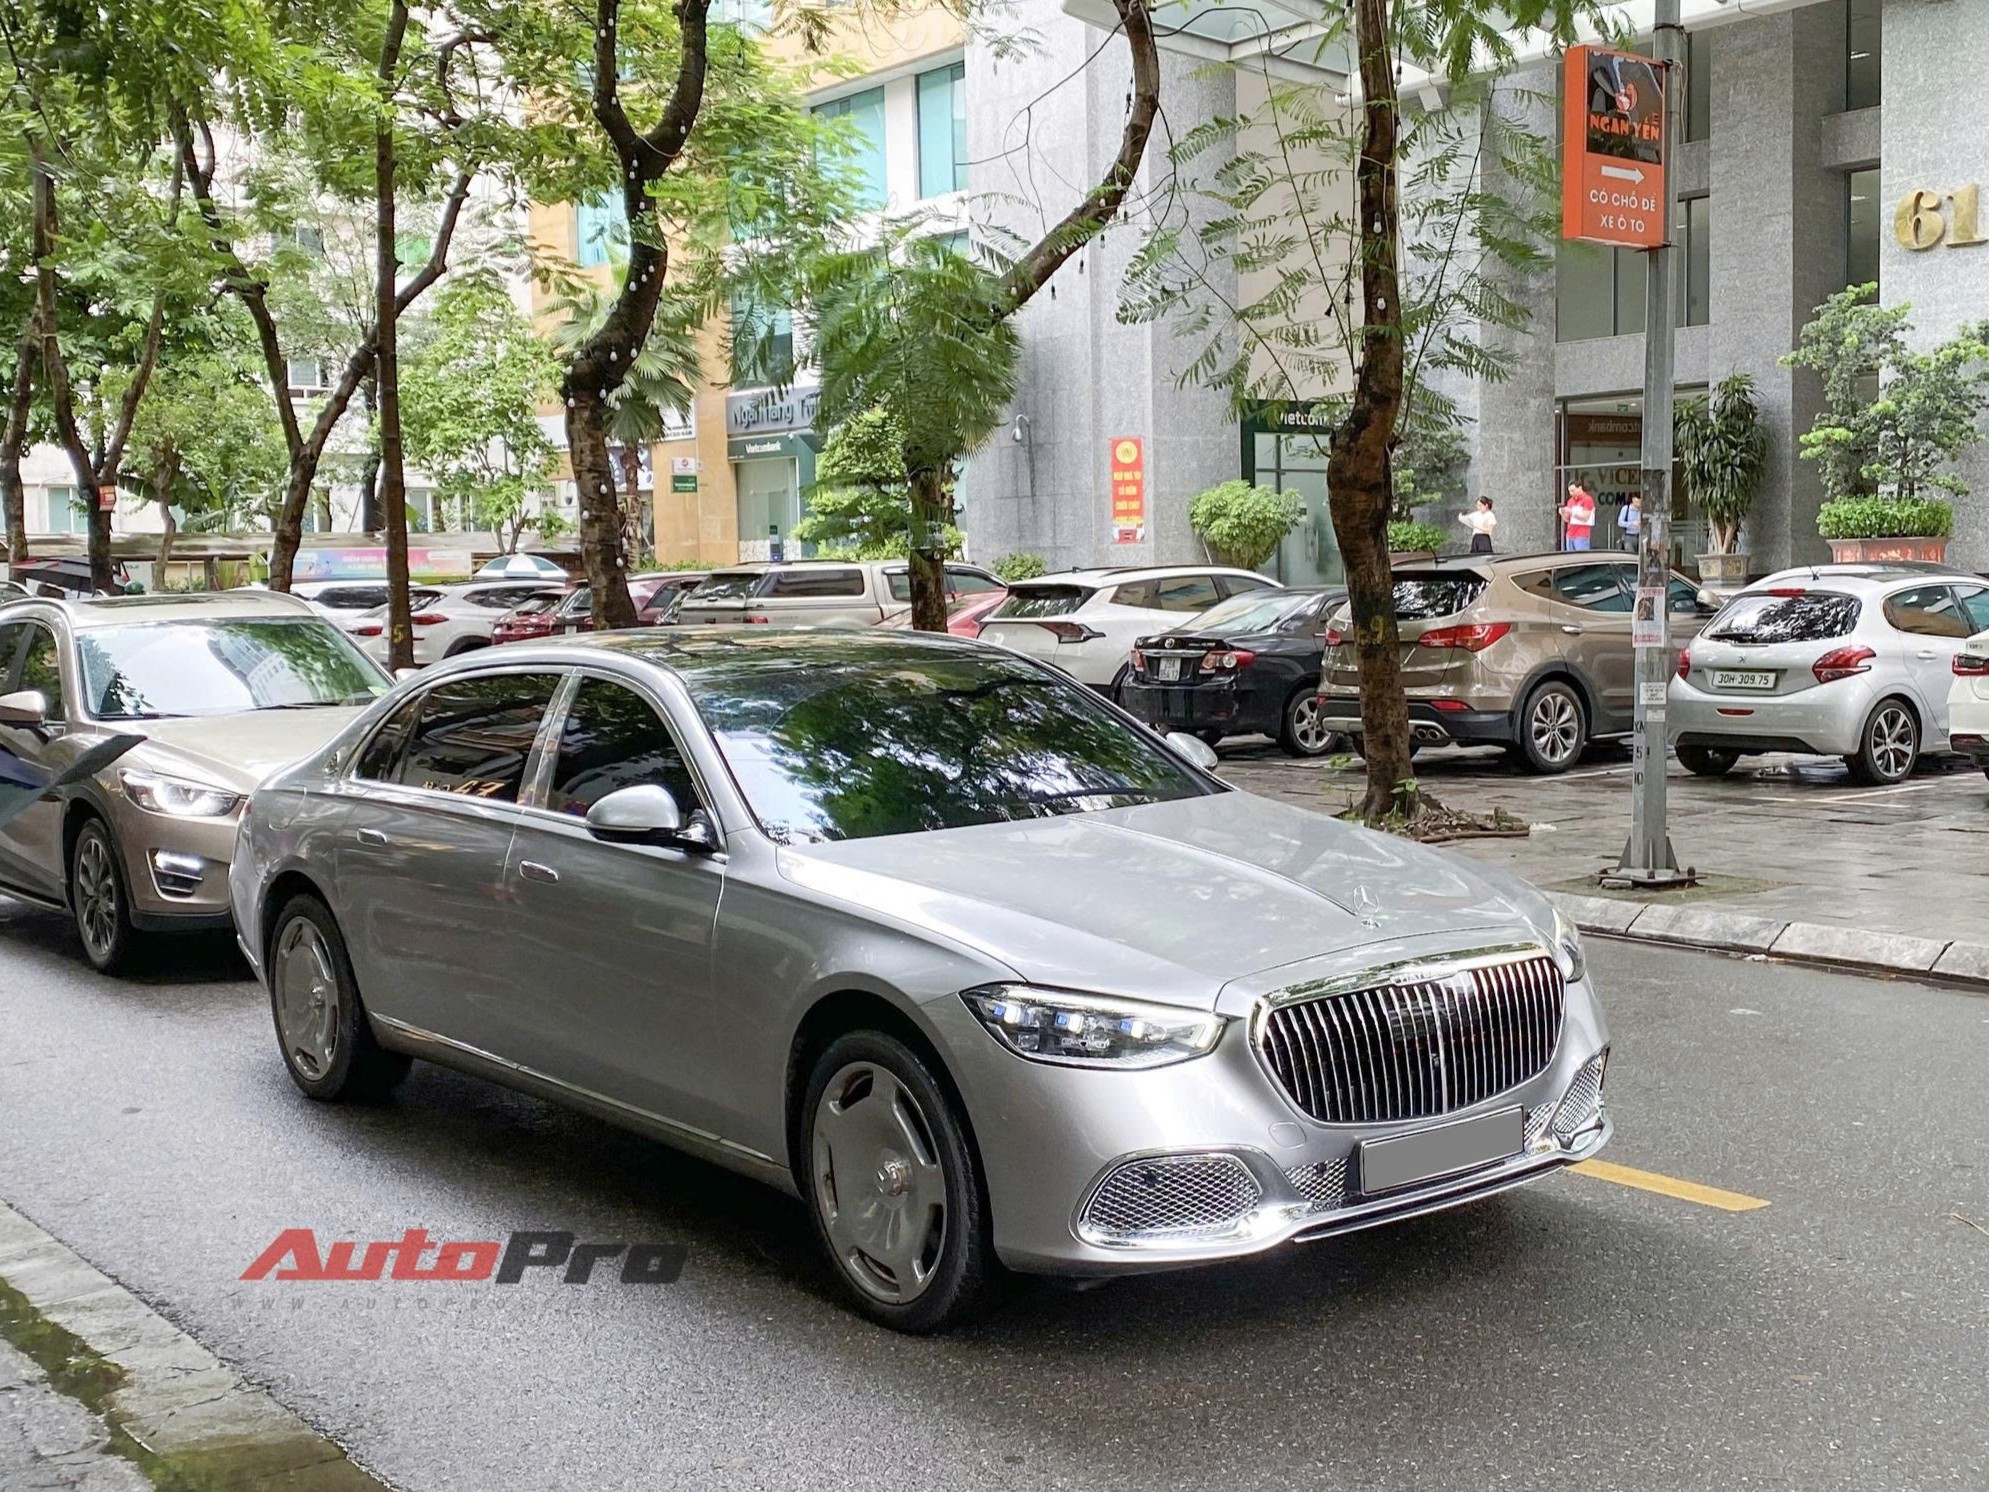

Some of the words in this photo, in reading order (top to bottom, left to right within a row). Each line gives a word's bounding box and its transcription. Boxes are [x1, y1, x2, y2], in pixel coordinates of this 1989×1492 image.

[1600, 214, 1614, 229] XE
[1894, 183, 1989, 251] 61
[1598, 467, 1641, 485] VICE
